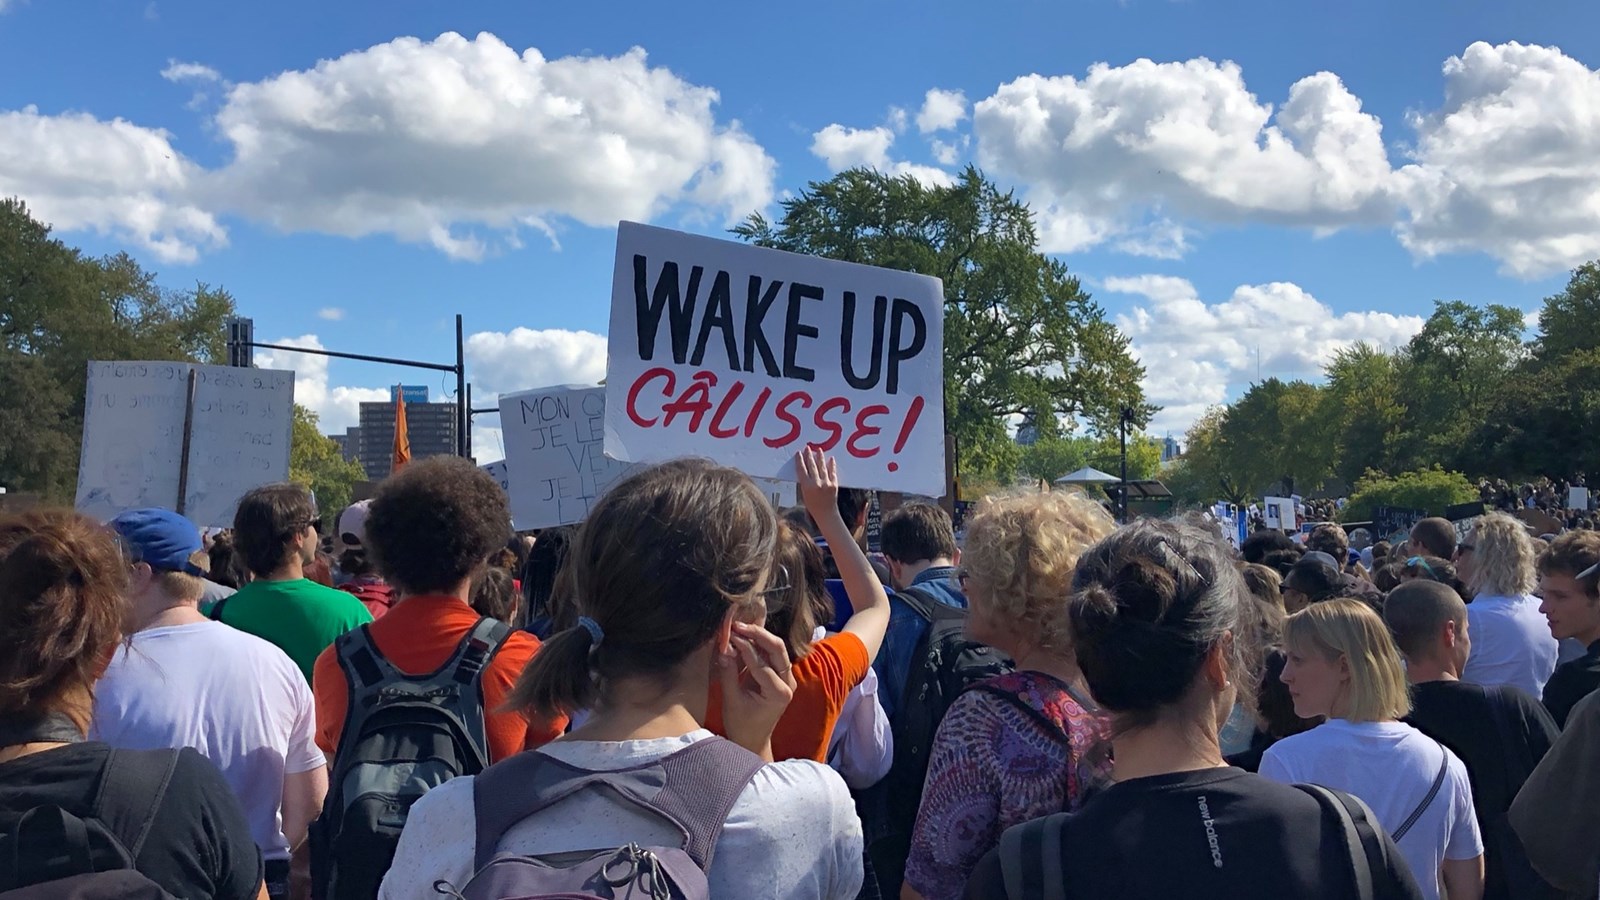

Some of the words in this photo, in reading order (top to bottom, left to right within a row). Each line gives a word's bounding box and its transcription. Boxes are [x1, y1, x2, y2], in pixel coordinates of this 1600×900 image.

[633, 254, 824, 382] WAKE
[841, 291, 927, 395] UP
[520, 396, 569, 425] MON
[626, 367, 925, 473] CÂLISSE!
[531, 423, 567, 451] JE
[541, 477, 573, 502] JE
[1197, 795, 1211, 819] new
[1204, 819, 1223, 868] balance
